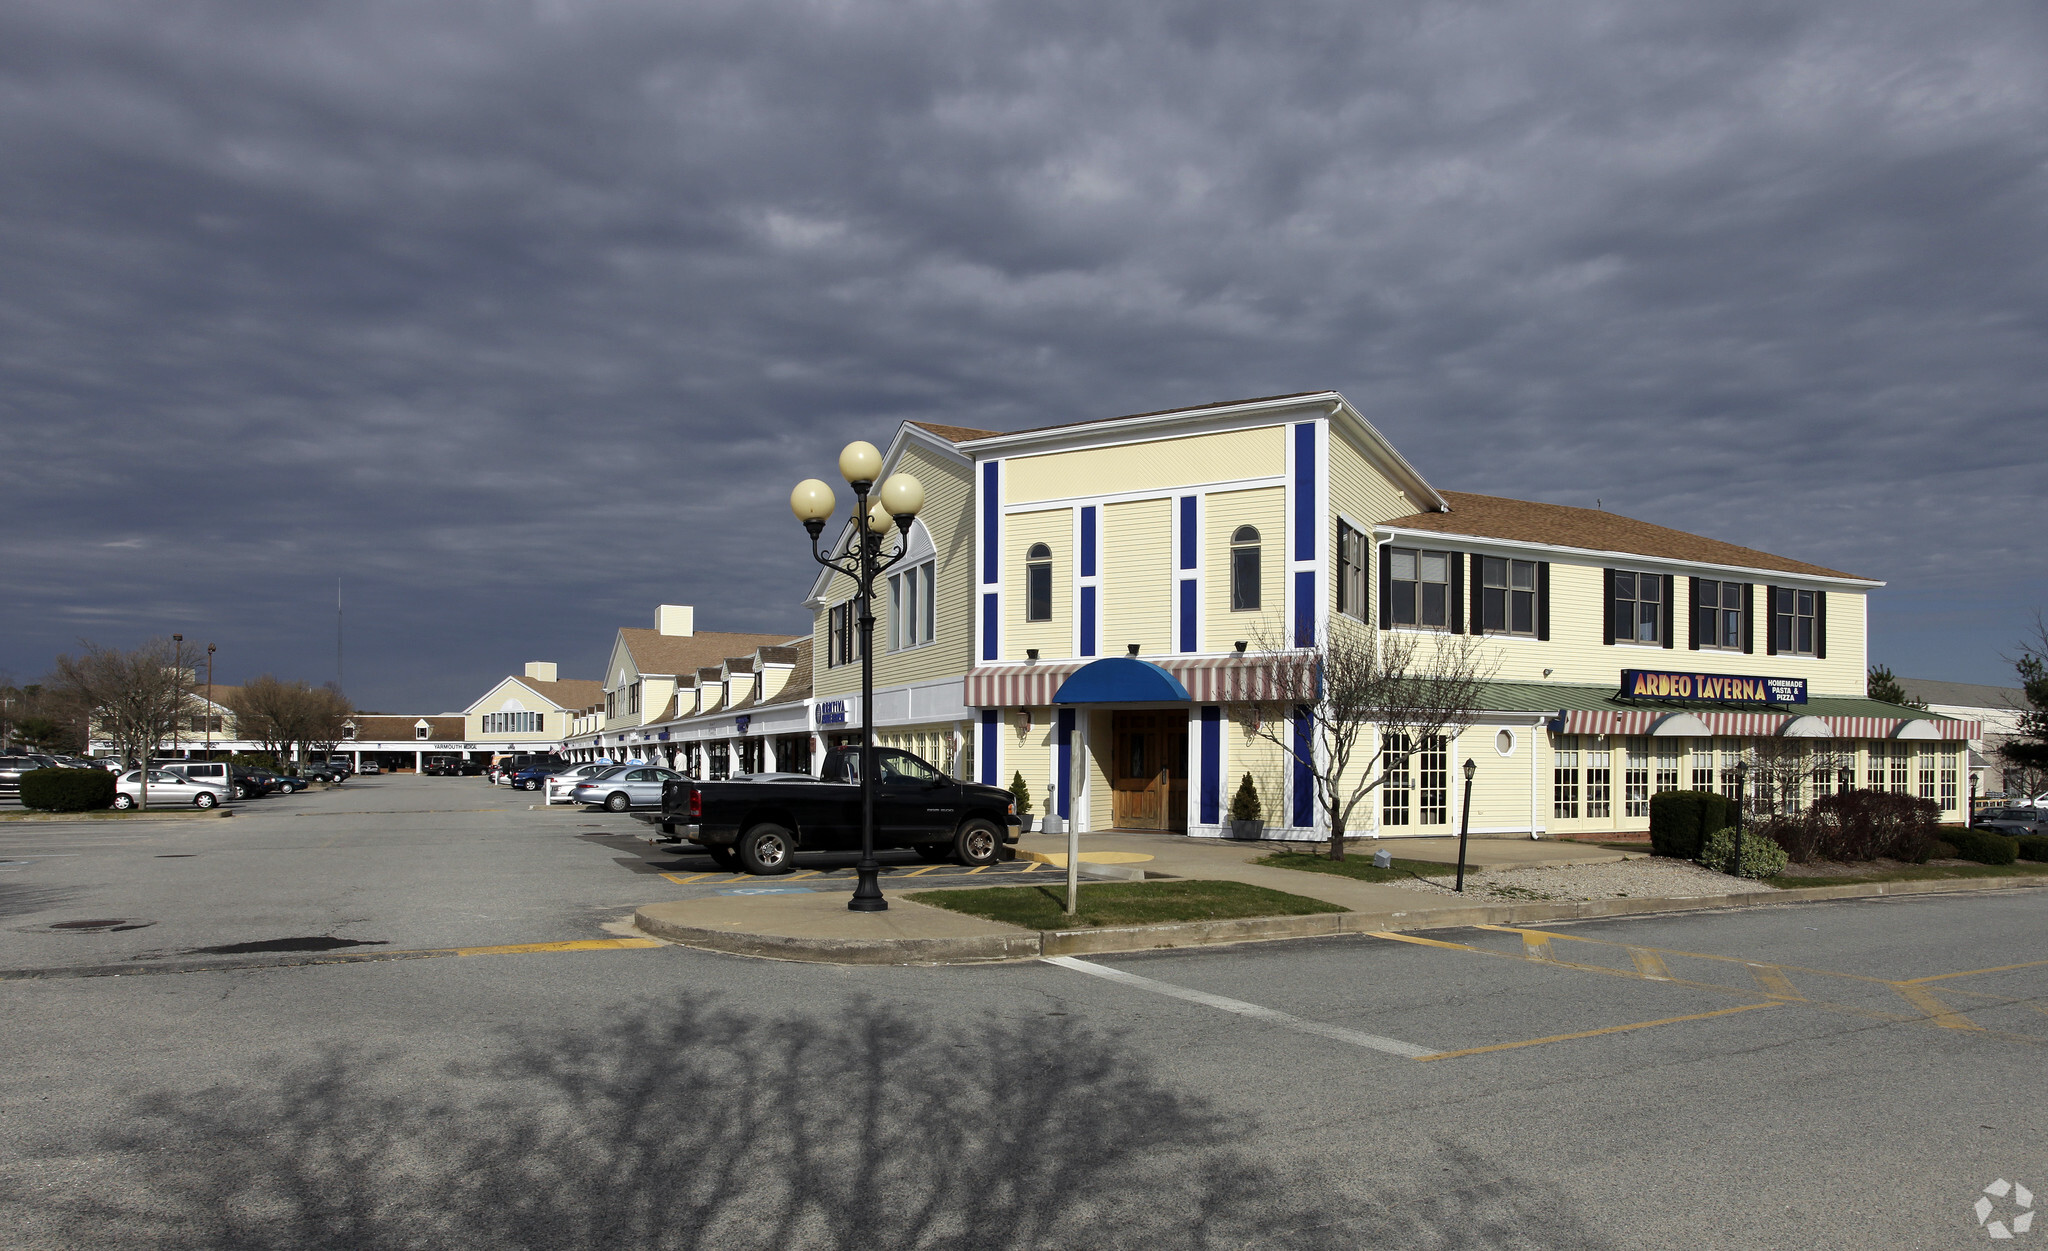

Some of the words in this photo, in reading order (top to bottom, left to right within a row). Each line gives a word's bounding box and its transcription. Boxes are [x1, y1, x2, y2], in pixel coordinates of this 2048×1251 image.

[1634, 673, 1691, 696] ARDEO
[1695, 674, 1766, 700] TAVERNA
[1768, 679, 1803, 688] HOMEMADE
